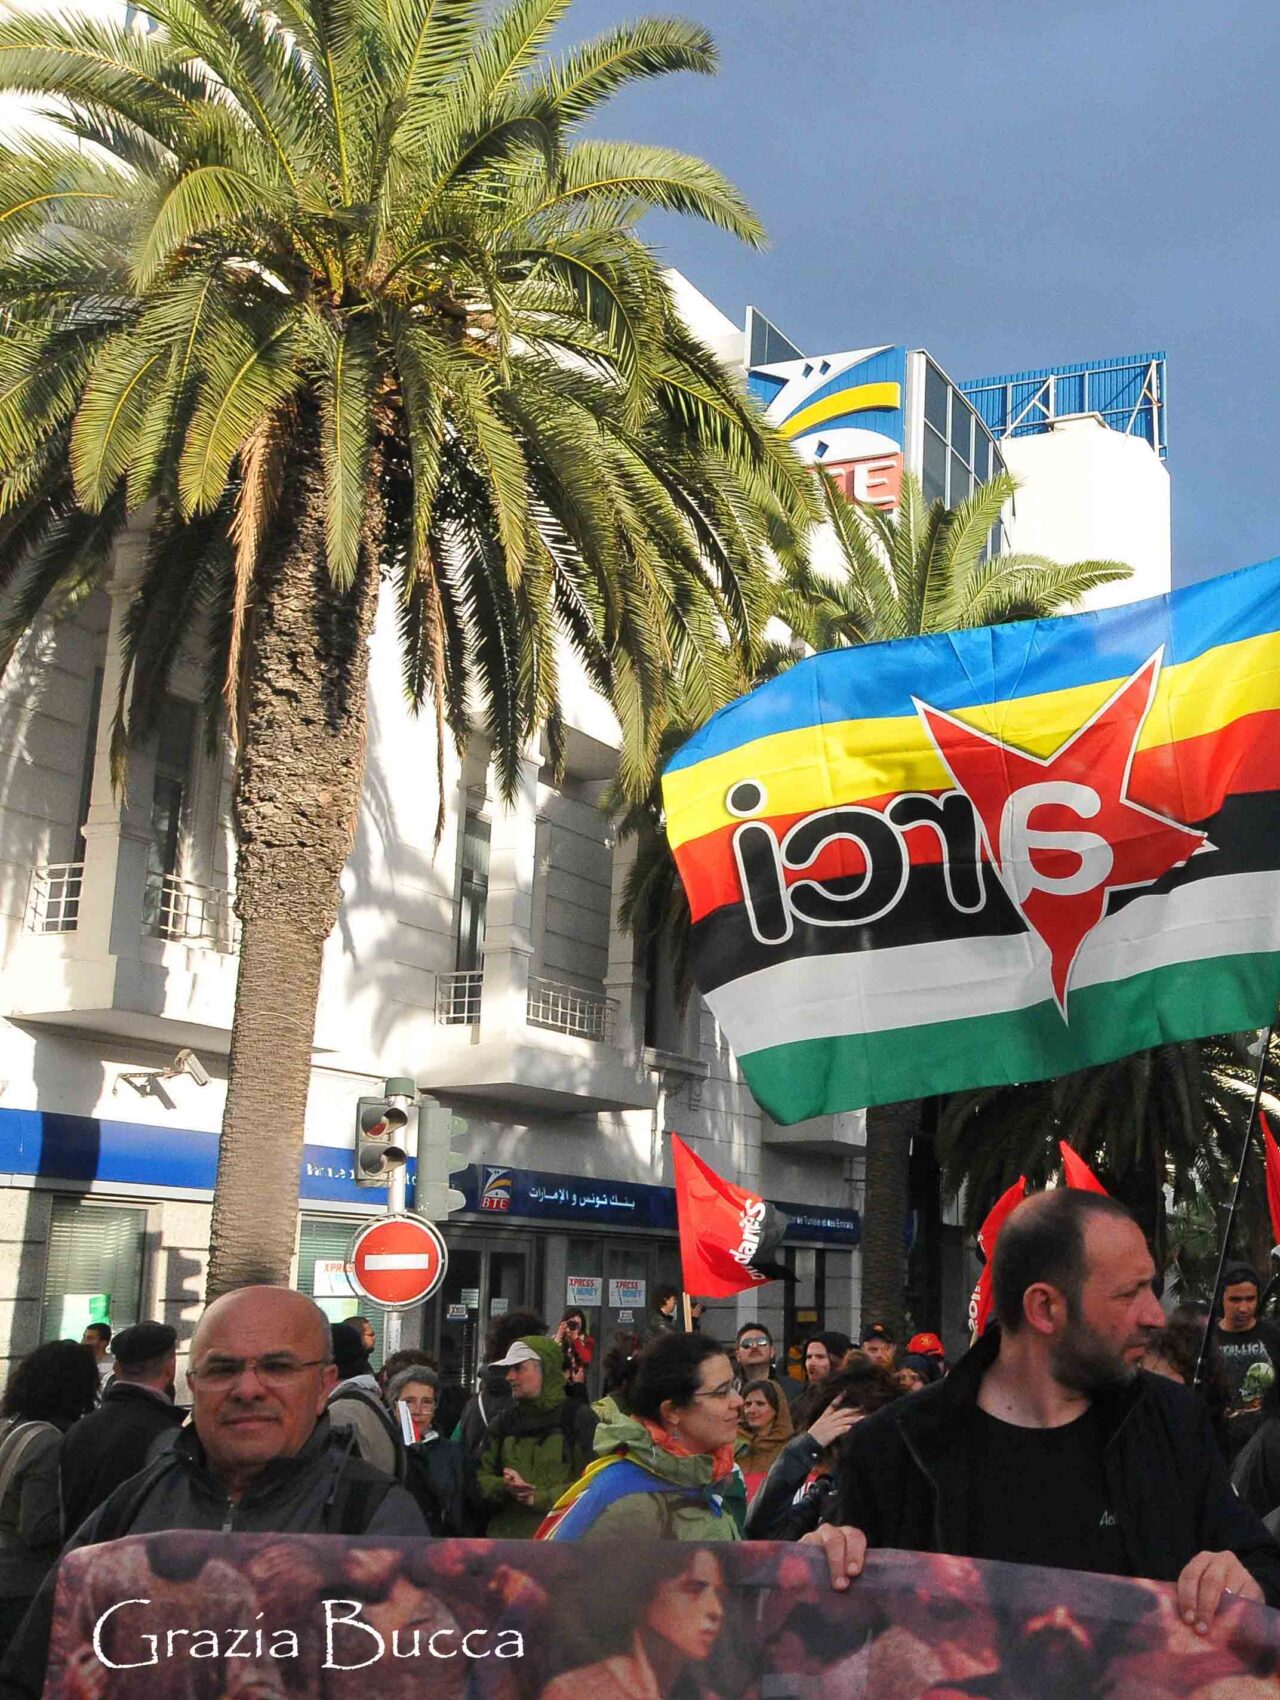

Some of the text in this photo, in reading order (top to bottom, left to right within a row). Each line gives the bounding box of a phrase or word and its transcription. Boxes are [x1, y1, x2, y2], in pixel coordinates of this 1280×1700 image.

[482, 1197, 509, 1210] BTE
[578, 1192, 608, 1209] تونس
[569, 1278, 595, 1288] XPRESS
[615, 1280, 639, 1289] XPRESS
